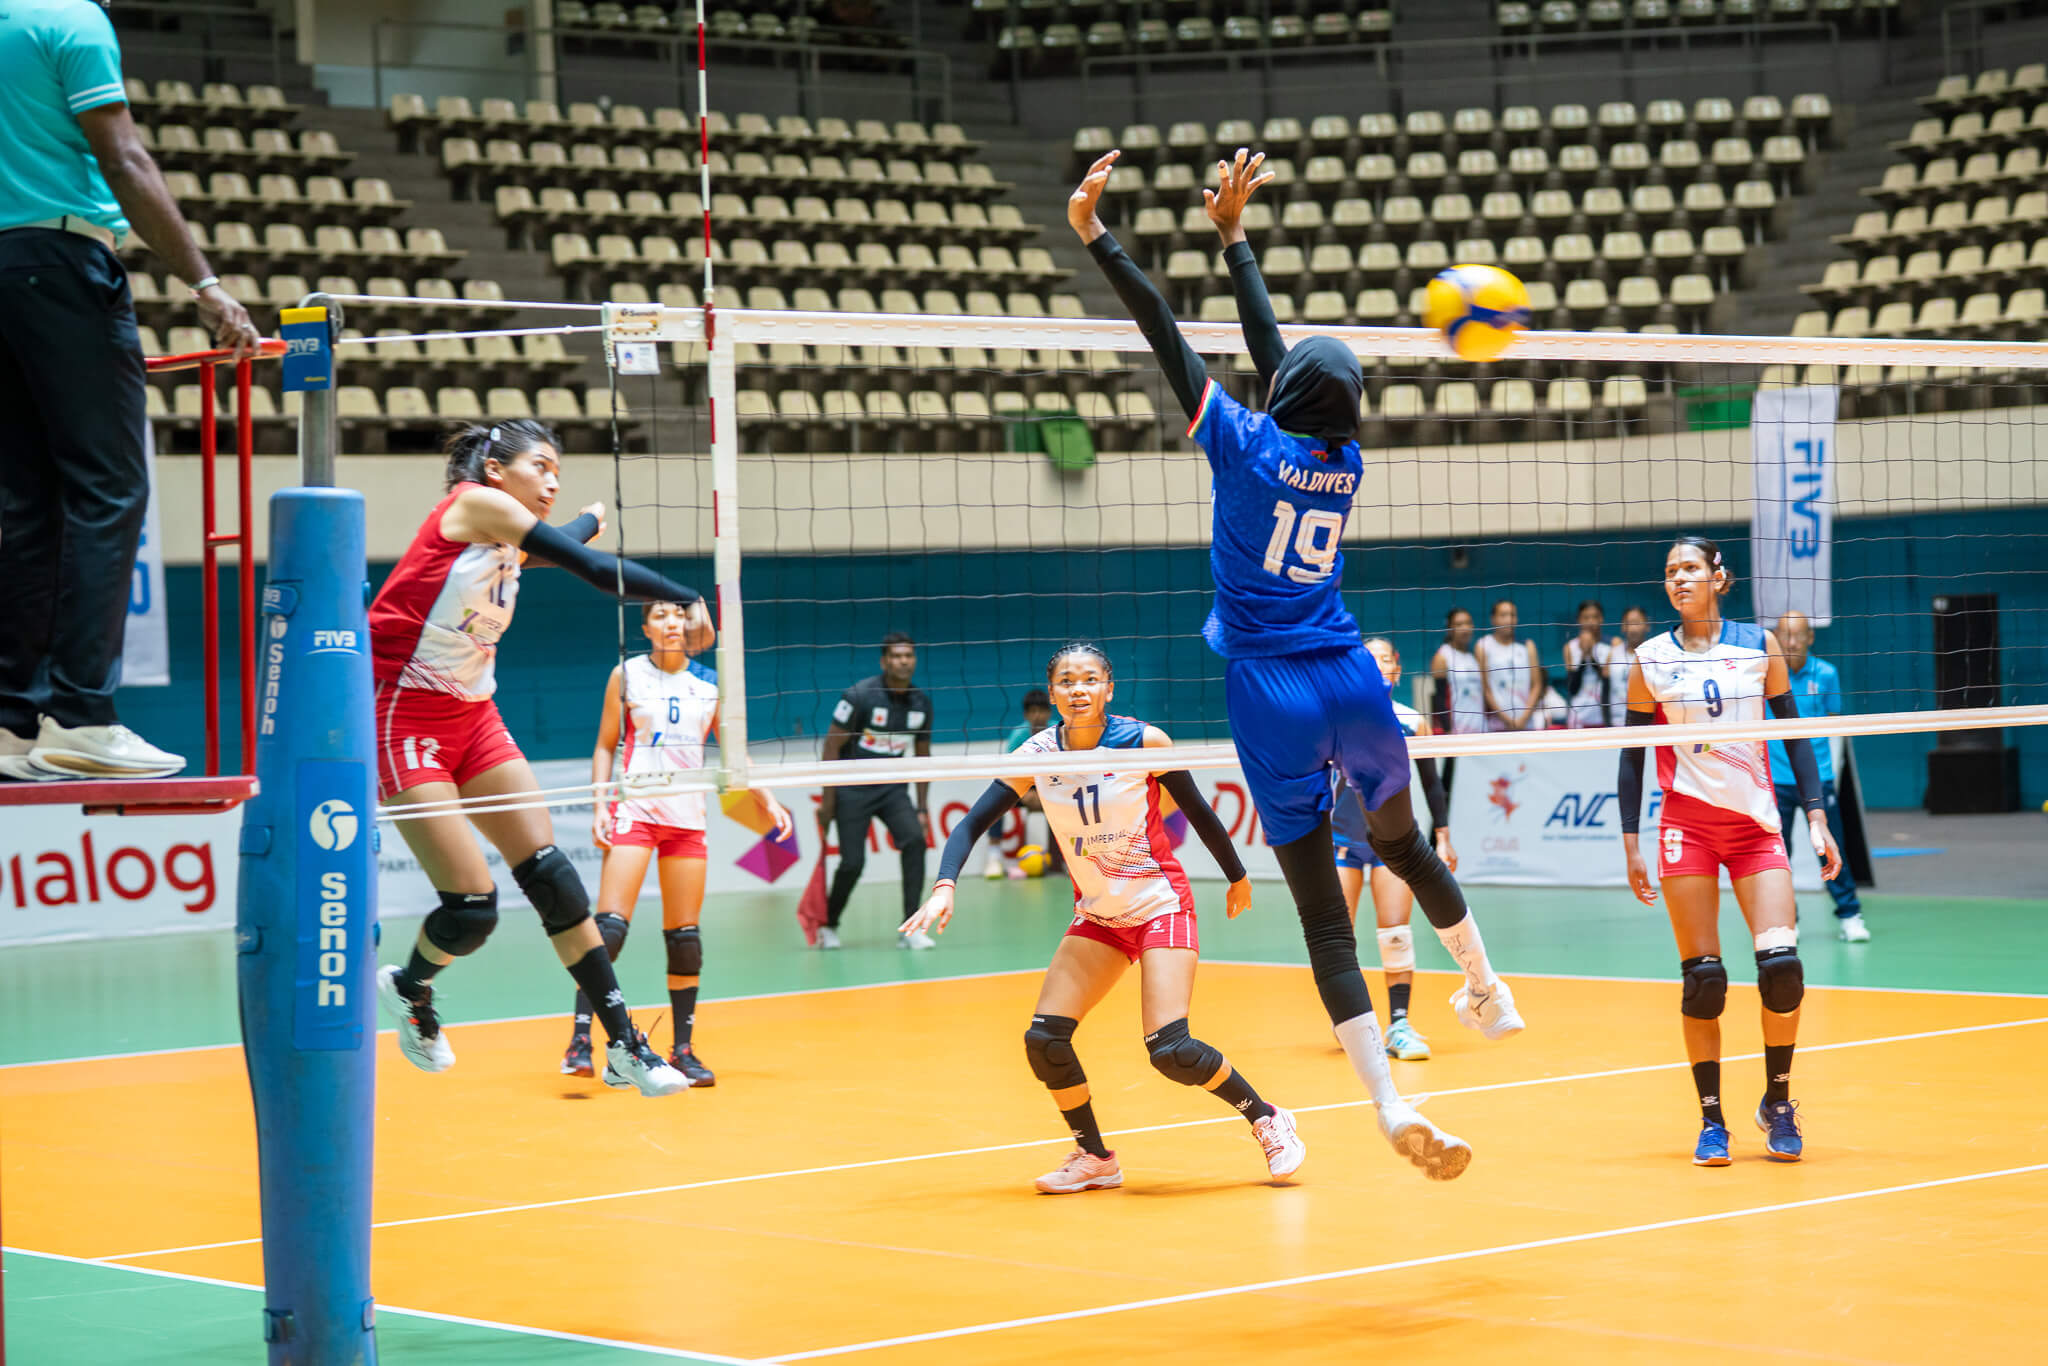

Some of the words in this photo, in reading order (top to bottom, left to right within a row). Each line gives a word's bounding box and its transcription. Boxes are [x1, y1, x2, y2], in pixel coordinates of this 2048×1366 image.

[287, 338, 320, 353] FIVB
[1278, 459, 1356, 494] MALDIVES
[1791, 438, 1824, 560] FIVB
[1263, 500, 1342, 583] 19
[314, 631, 357, 647] FIVB
[668, 696, 681, 724] 6
[1702, 679, 1723, 718] 9
[403, 736, 441, 769] 12
[1072, 784, 1101, 826] 17
[1544, 793, 1619, 828] AVC
[1663, 827, 1684, 864] 9
[0, 829, 217, 914] ialog
